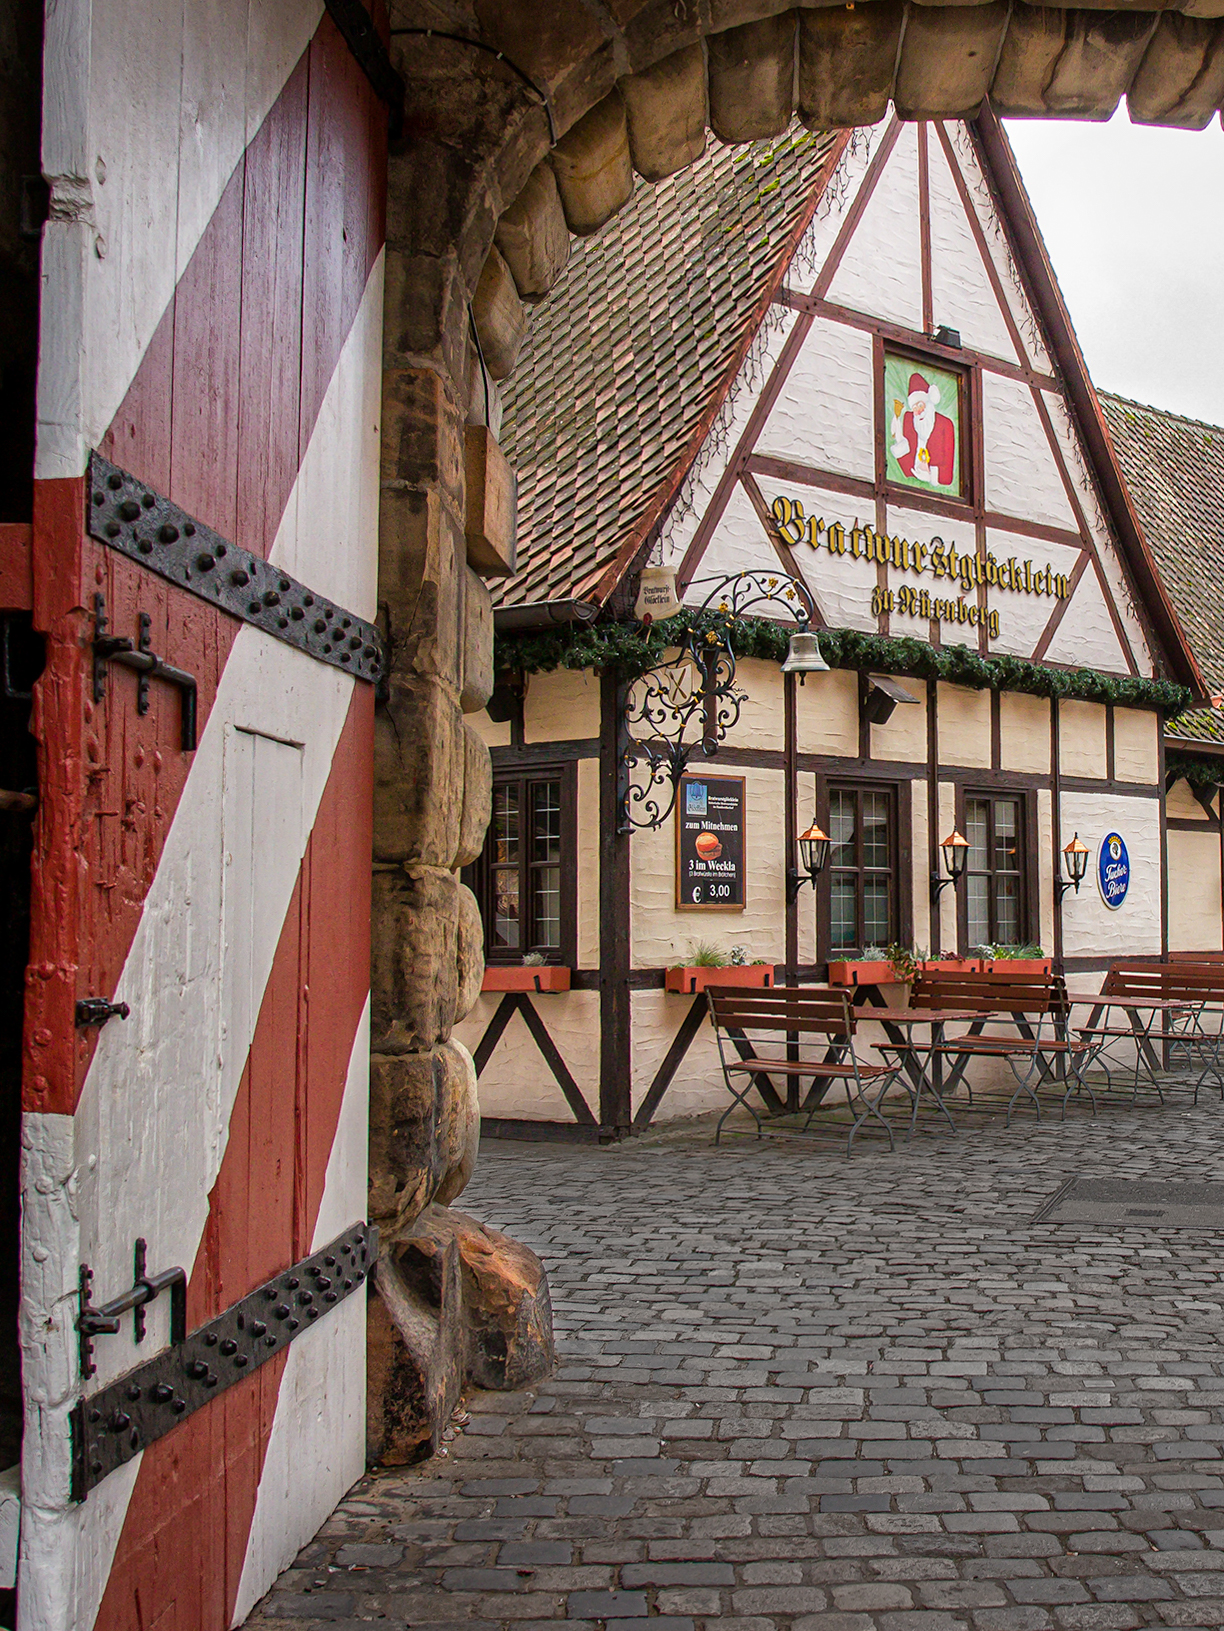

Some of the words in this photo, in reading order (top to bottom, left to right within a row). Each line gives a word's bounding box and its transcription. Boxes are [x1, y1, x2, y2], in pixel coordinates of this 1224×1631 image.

[771, 496, 1070, 599] Bratwurstglöcklein
[871, 585, 895, 616] zu
[899, 585, 1000, 638] Nürnberg
[685, 821, 699, 830] zum
[701, 821, 738, 831] Mitnehmen
[689, 860, 694, 870] 3
[696, 860, 706, 870] im
[708, 860, 736, 872] Weckla
[1105, 863, 1128, 882] Tucher
[692, 886, 702, 903] €
[709, 884, 730, 898] 3,00
